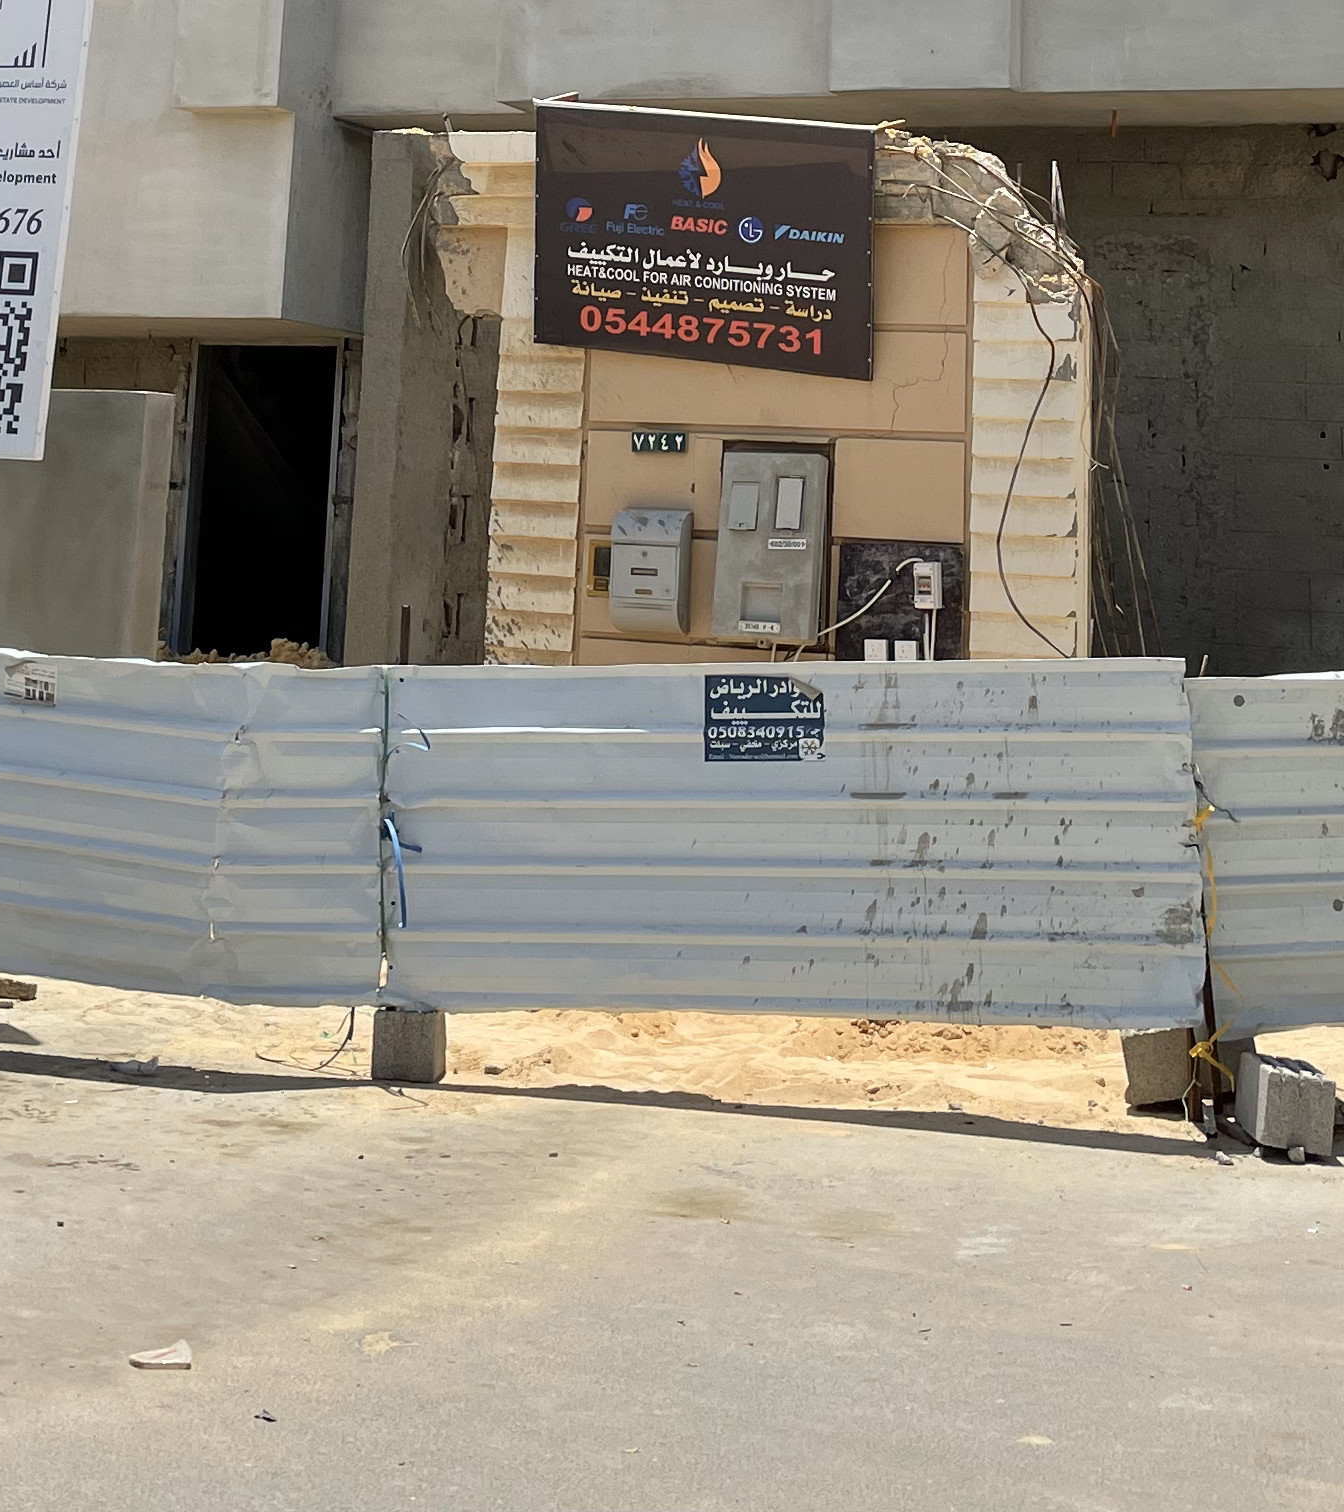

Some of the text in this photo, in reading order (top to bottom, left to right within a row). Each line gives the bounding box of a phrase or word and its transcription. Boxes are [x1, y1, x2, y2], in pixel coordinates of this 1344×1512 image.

[20, 76, 44, 90] أساس
[45, 79, 68, 91] شركة
[18, 97, 67, 105] DEVELOPMENT
[37, 140, 62, 159] أحد
[606, 221, 665, 237] Fuji Electric
[670, 215, 728, 235] BASIC
[788, 228, 845, 244] DAIKIN
[567, 241, 639, 266] التكييف
[642, 248, 702, 269] لأعمال
[567, 263, 837, 302] HEAT&COOL FOR AIR CONDITIONING SYSTEM
[570, 278, 622, 302] صيانة
[641, 286, 690, 307] تنفيذ
[708, 297, 765, 314] تصميم
[784, 299, 832, 323] دراسة
[579, 305, 822, 355] 0544875731
[709, 678, 767, 700] الرياض
[710, 699, 822, 726] للتكييف
[707, 725, 805, 739] 0508340915
[771, 739, 798, 752] مركزي
